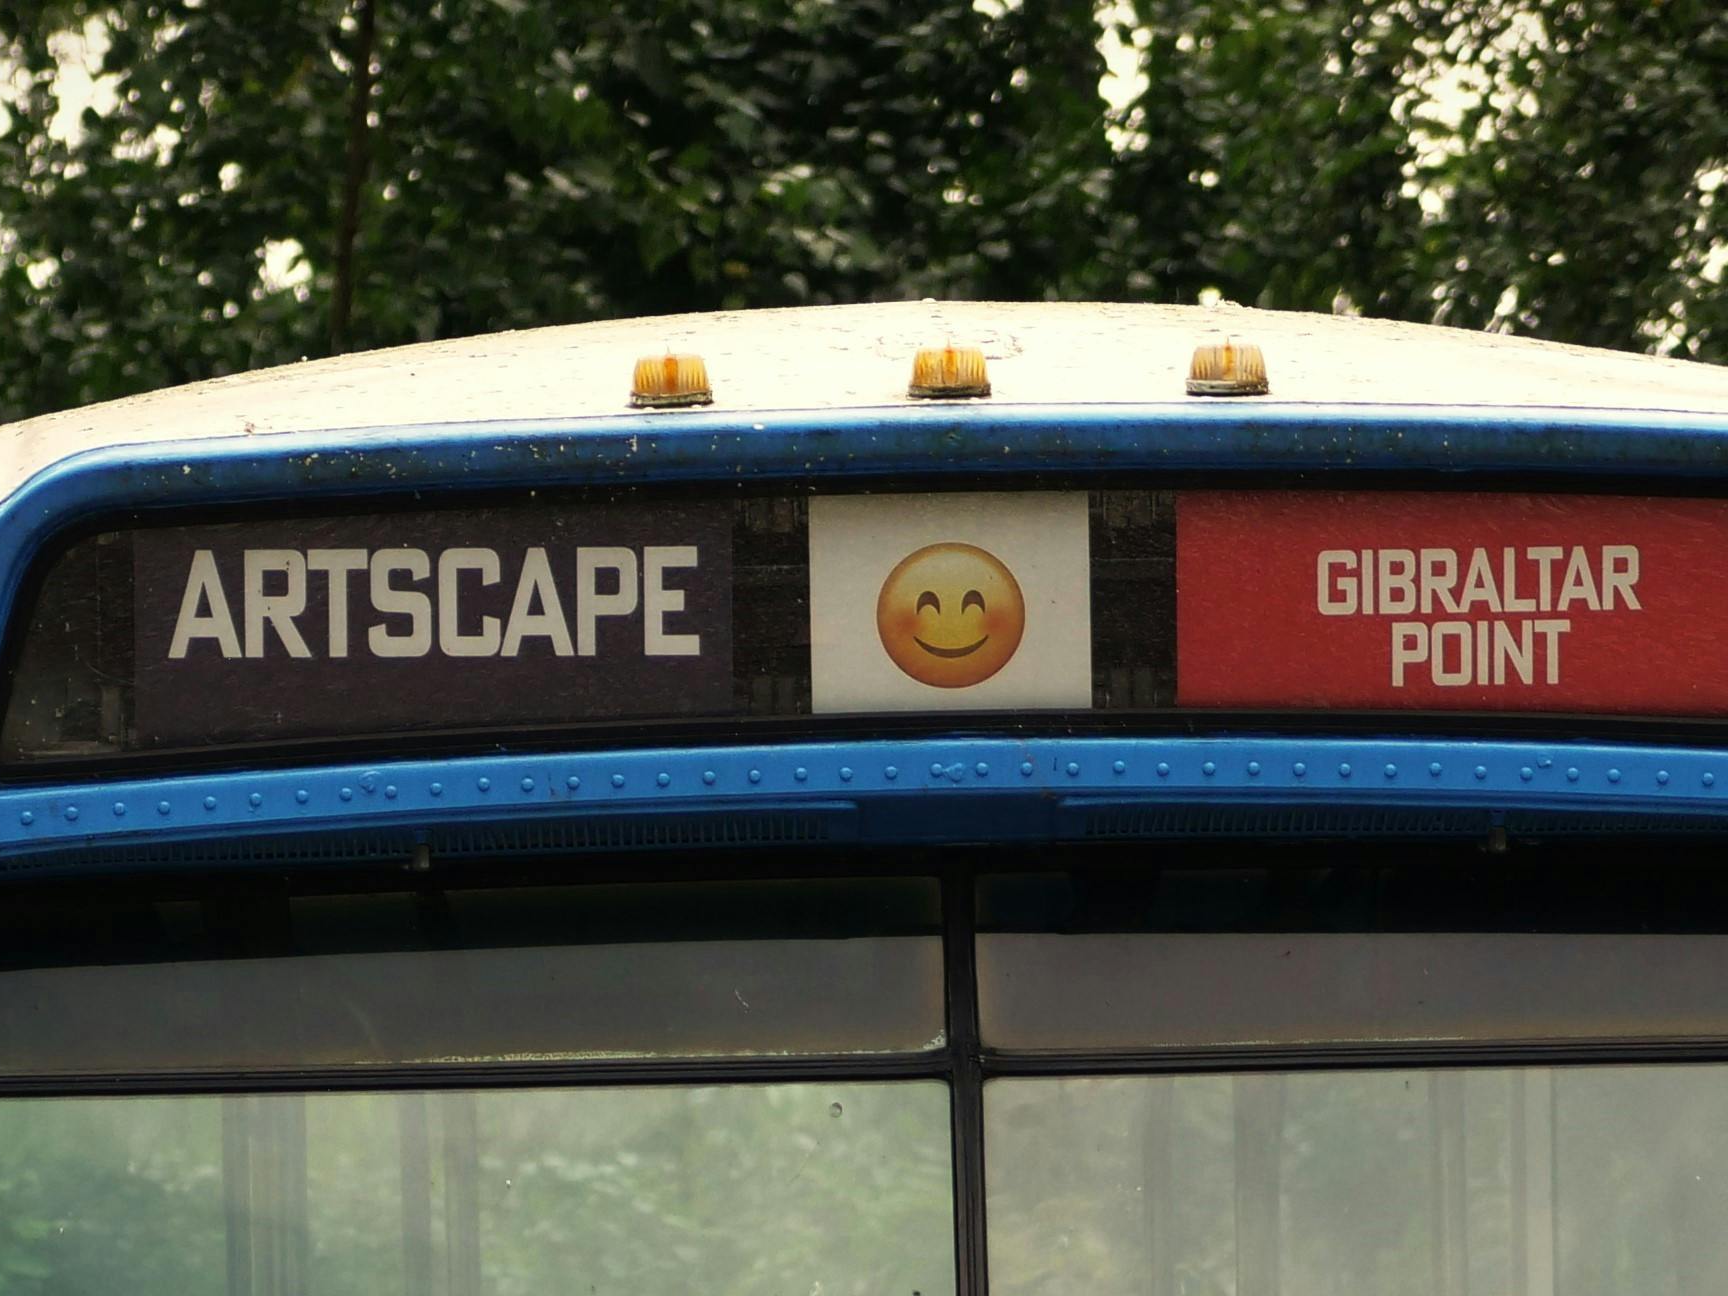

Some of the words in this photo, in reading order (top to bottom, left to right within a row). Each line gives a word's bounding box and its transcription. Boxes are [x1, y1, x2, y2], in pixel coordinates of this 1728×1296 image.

[168, 546, 700, 658] ARTSCAPE
[1317, 545, 1642, 615] GIBRALTAR
[1391, 619, 1570, 687] POINT
